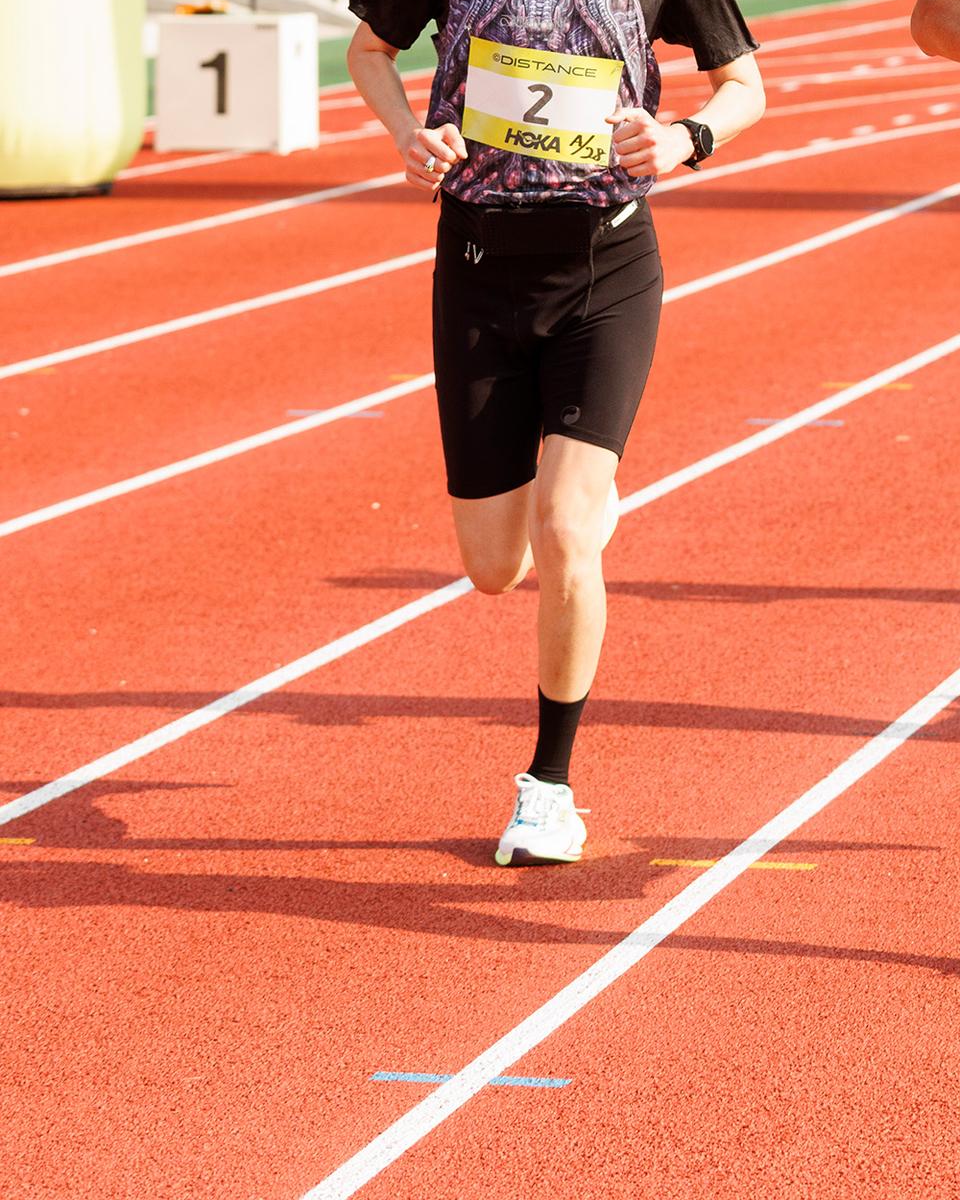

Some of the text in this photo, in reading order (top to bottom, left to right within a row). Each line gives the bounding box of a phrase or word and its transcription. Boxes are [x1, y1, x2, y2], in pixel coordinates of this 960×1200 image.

[200, 52, 227, 115] 1
[522, 83, 554, 126] 2
[504, 128, 561, 154] HOKA
[569, 134, 607, 162] A/28
